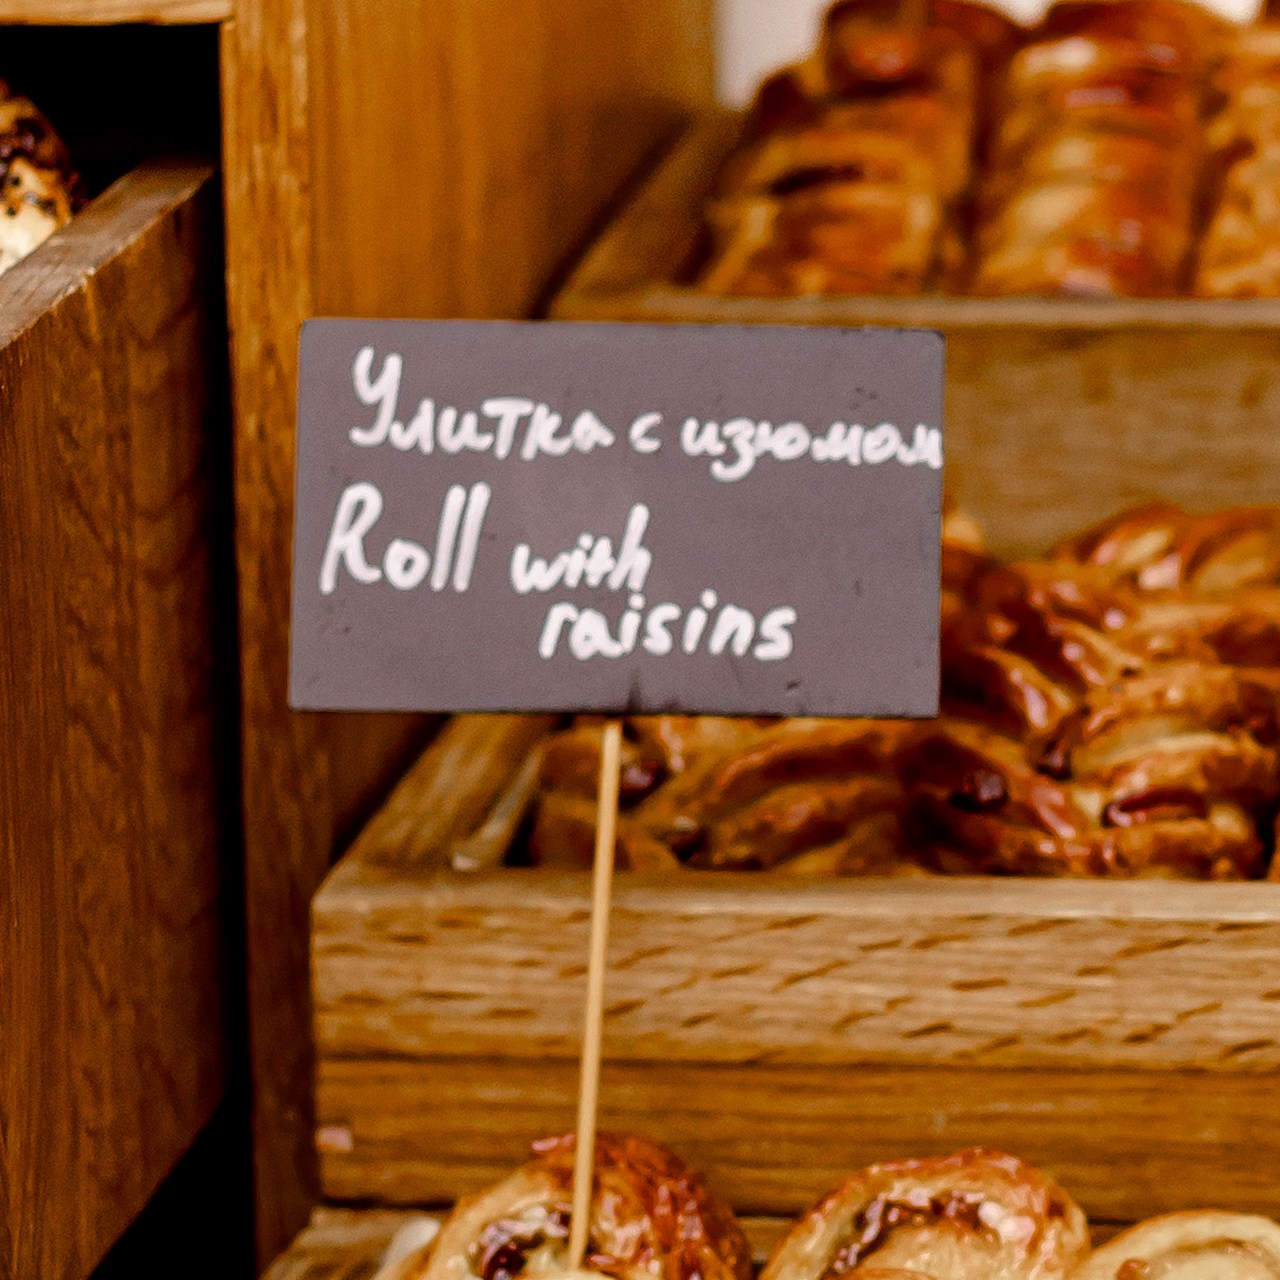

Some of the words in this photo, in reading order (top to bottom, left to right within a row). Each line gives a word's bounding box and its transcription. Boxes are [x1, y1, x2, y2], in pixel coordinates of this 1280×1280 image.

[349, 346, 615, 461] Улитка
[629, 411, 663, 453] с
[680, 417, 943, 482] изюмом
[320, 481, 491, 596] Roll
[510, 503, 652, 593] with
[537, 588, 797, 662] raisins
